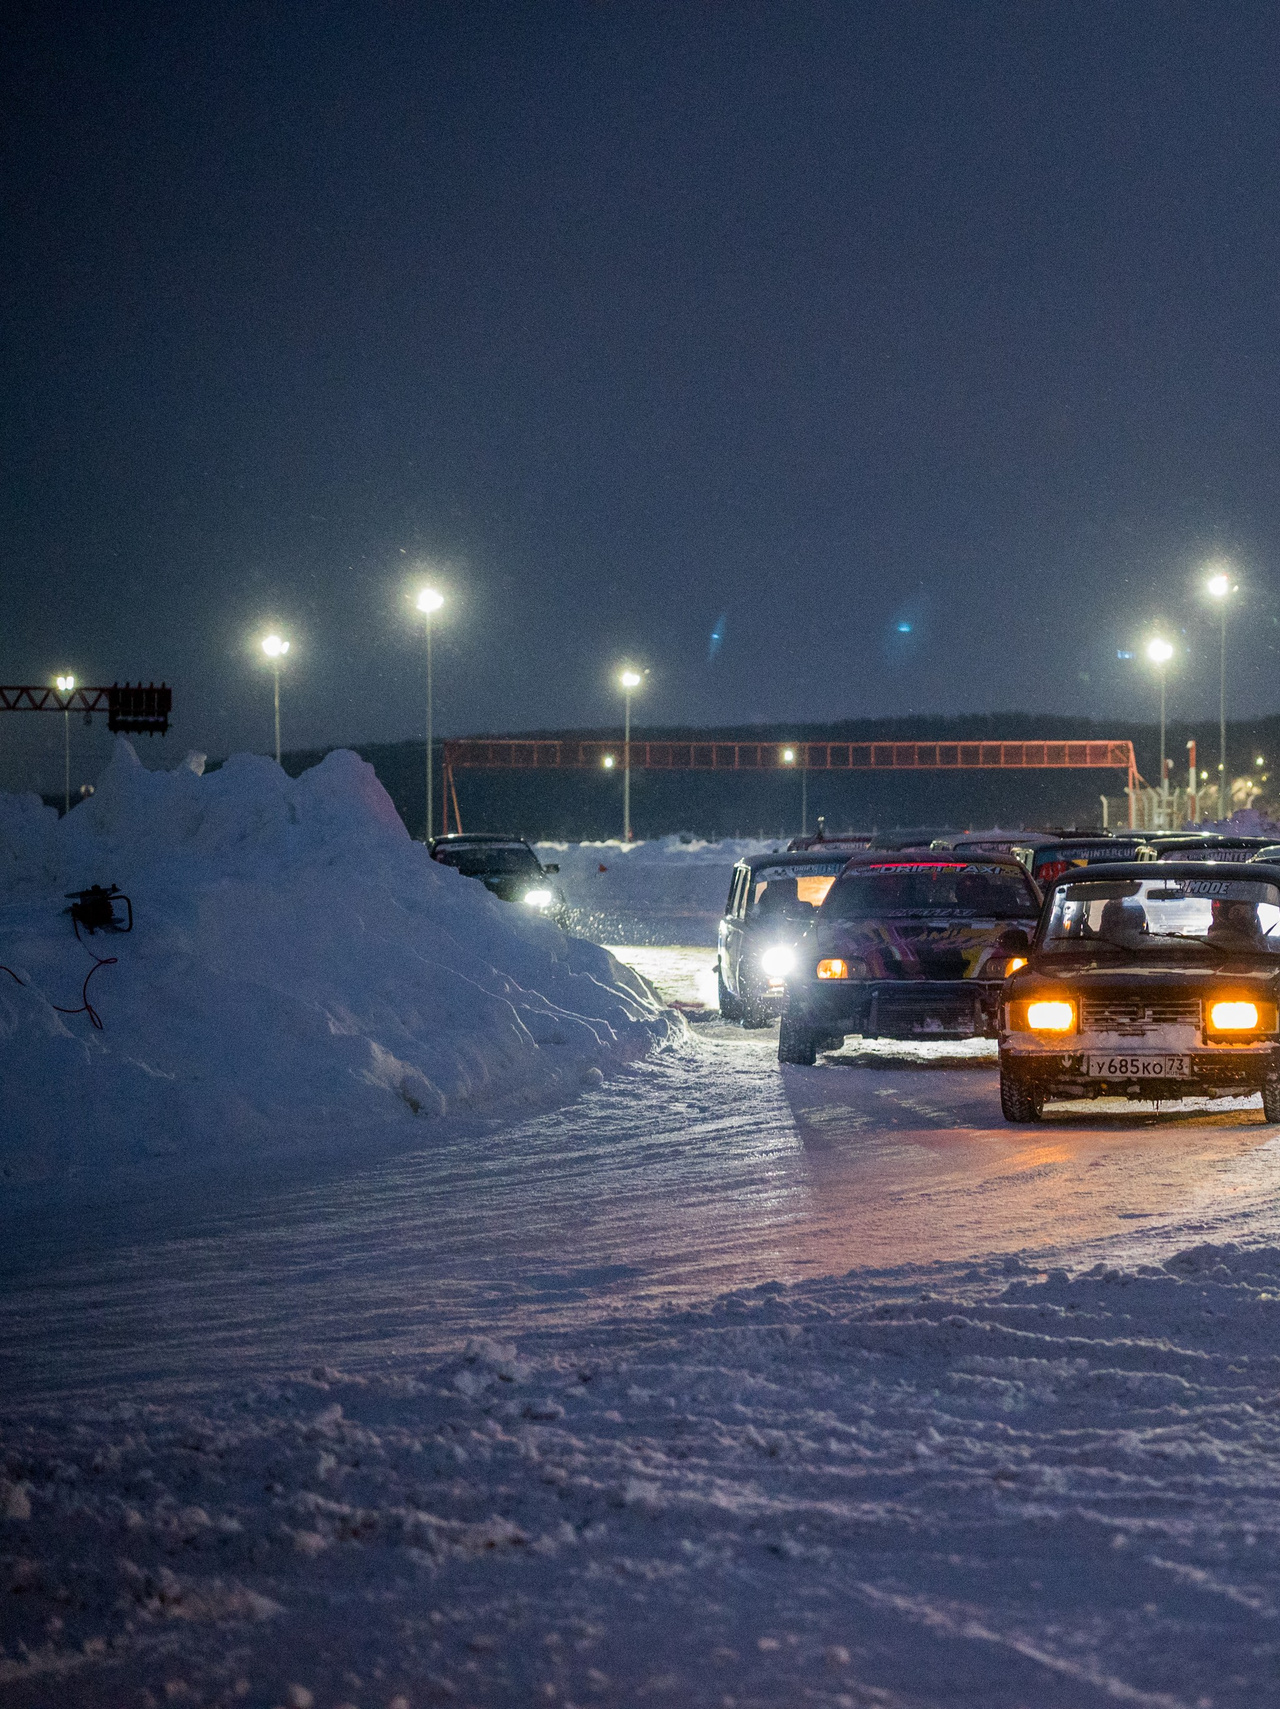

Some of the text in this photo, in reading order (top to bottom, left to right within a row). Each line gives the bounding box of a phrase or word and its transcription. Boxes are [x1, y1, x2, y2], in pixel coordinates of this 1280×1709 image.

[879, 865, 943, 874] DRIFT
[954, 865, 1001, 874] TAXI
[1188, 881, 1231, 895] MODE
[1167, 1058, 1184, 1071] 73
